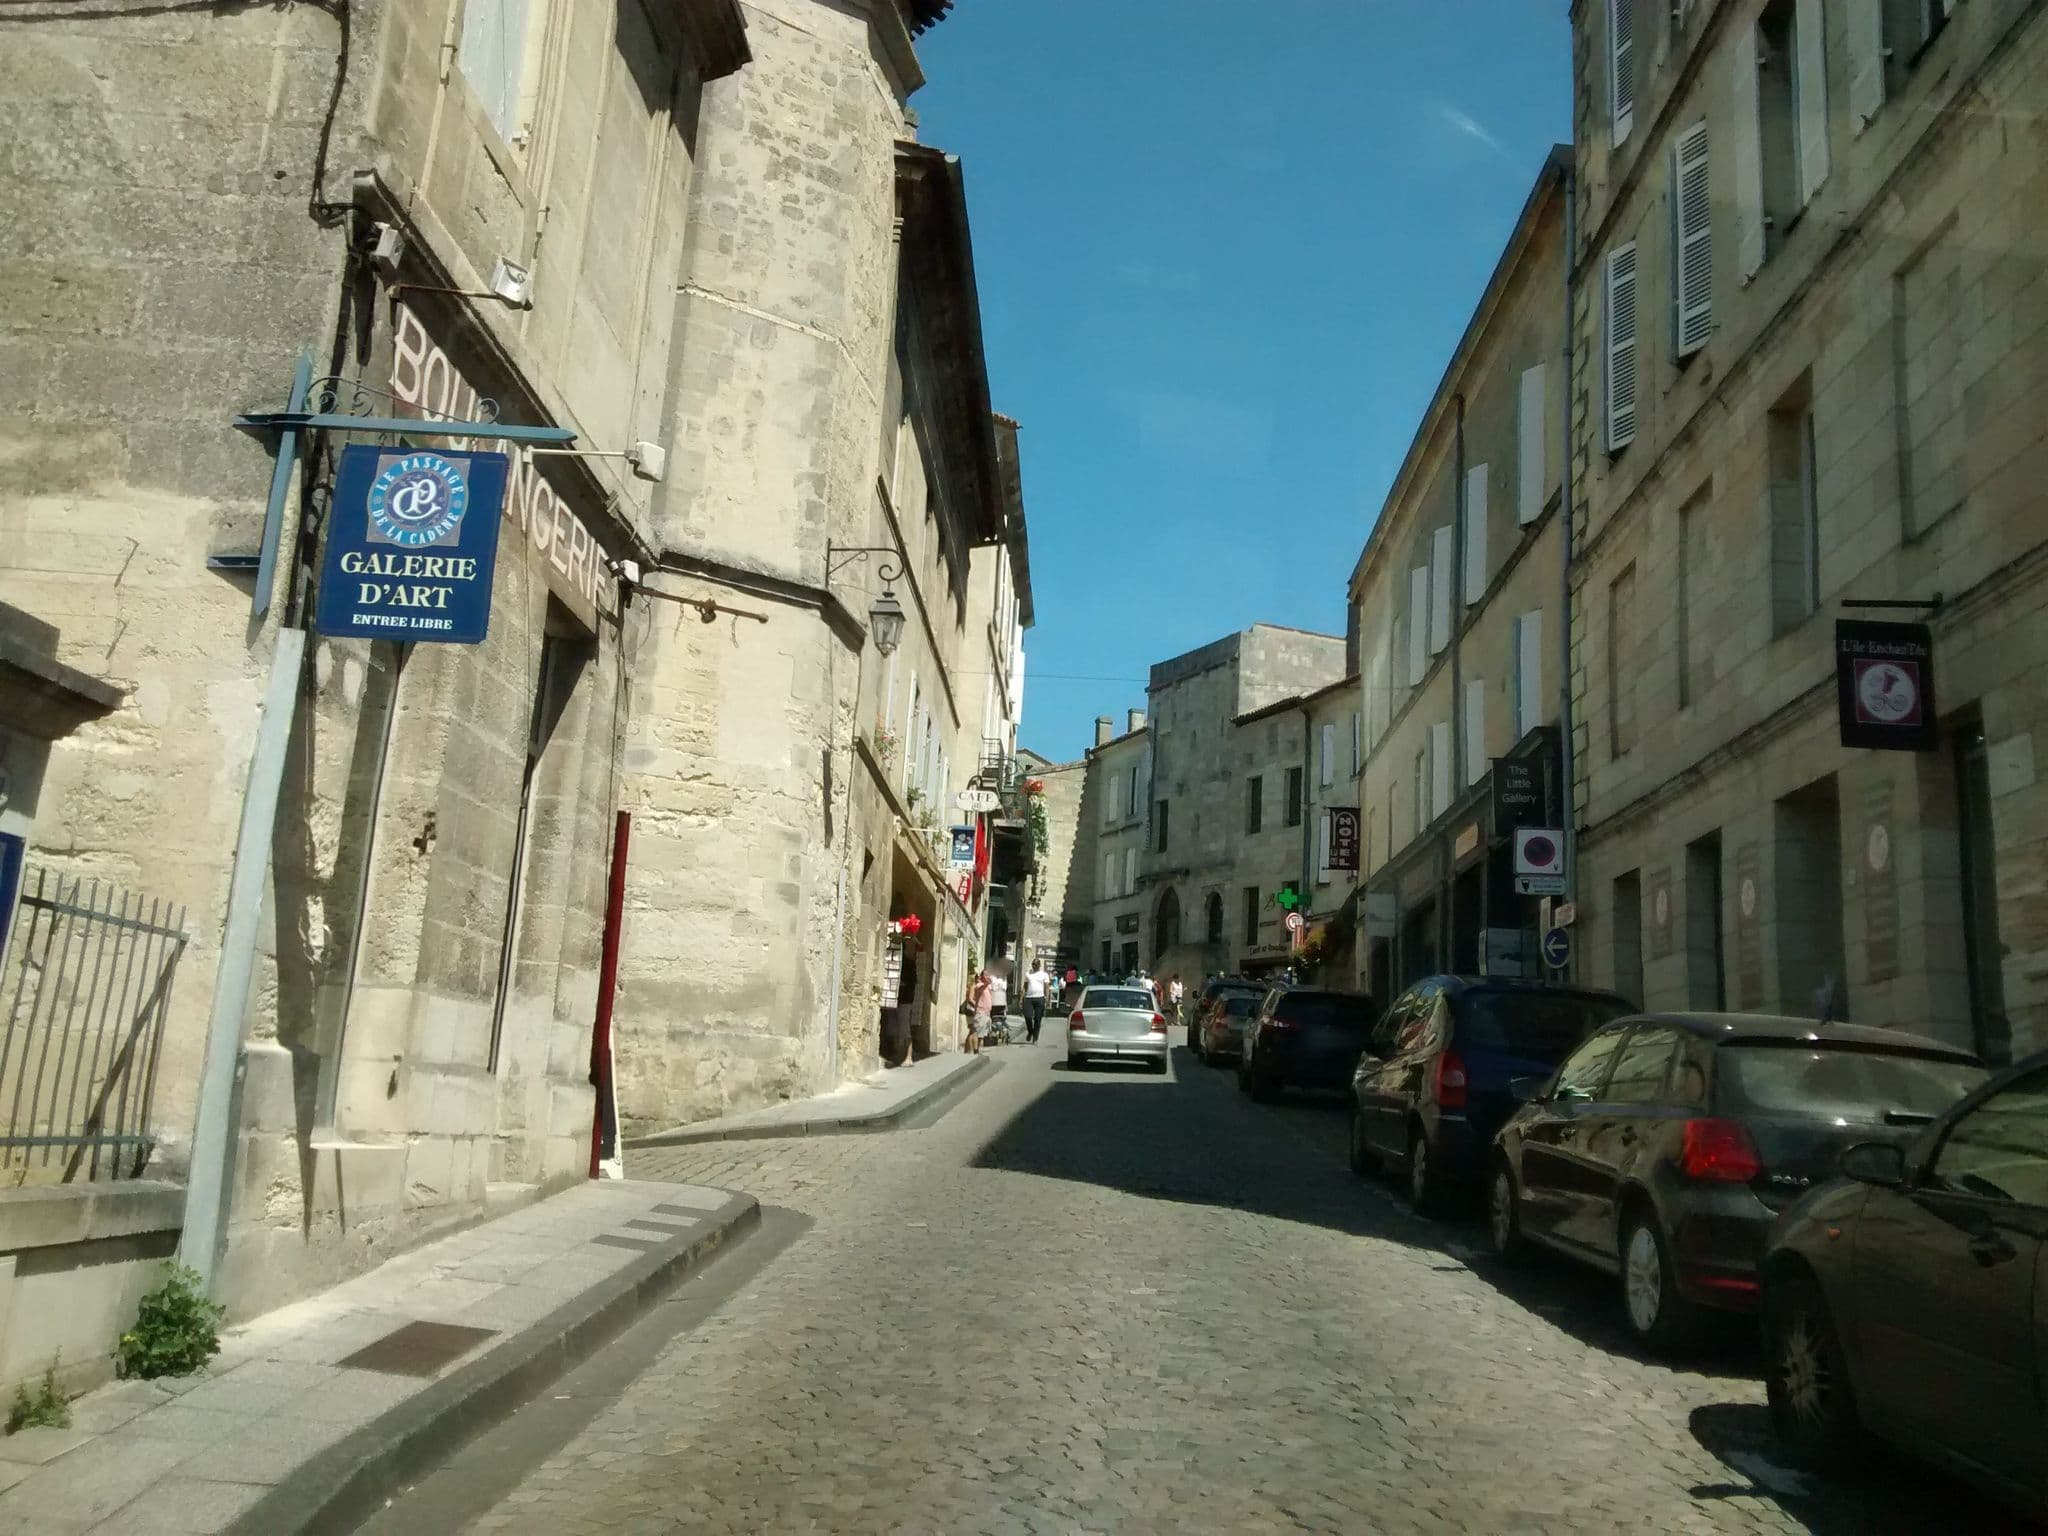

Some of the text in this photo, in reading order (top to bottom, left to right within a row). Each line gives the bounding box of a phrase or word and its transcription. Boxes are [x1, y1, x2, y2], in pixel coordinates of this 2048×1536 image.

[389, 302, 611, 607] BOUNGERIE
[376, 457, 465, 494] LE PASSAGE
[371, 510, 388, 527] DE
[386, 526, 402, 543] LA
[340, 551, 477, 581] GALERIE
[357, 583, 453, 608] D'ART
[352, 614, 453, 630] ENTREE LIBRE
[1508, 765, 1528, 776] The
[1506, 778, 1532, 789] Little
[1502, 792, 1537, 805] Gallery
